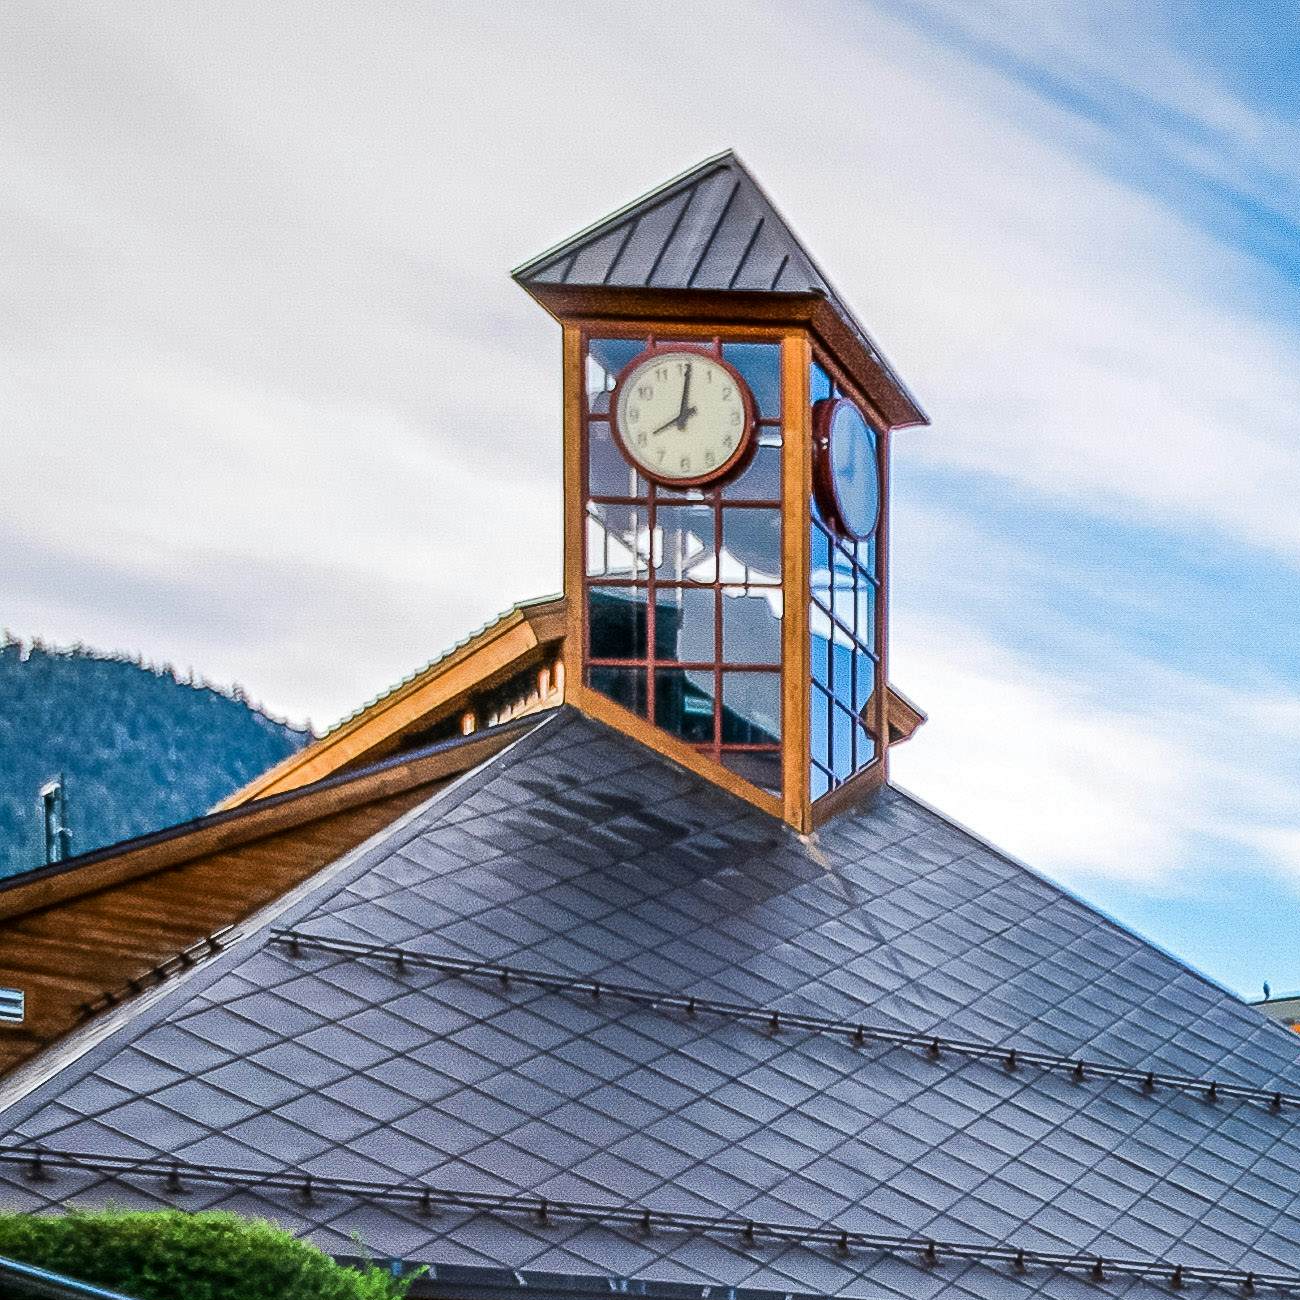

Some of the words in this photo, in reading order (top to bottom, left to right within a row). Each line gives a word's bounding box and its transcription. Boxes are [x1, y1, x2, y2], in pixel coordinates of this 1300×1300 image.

[655, 368, 668, 383] 11
[707, 370, 713, 383] 1
[637, 386, 654, 401] 10
[722, 387, 732, 401] 2
[730, 411, 741, 426] 3
[637, 432, 648, 447] 8
[722, 434, 733, 449] 4
[656, 449, 666, 463] 7
[680, 457, 690, 472] 6
